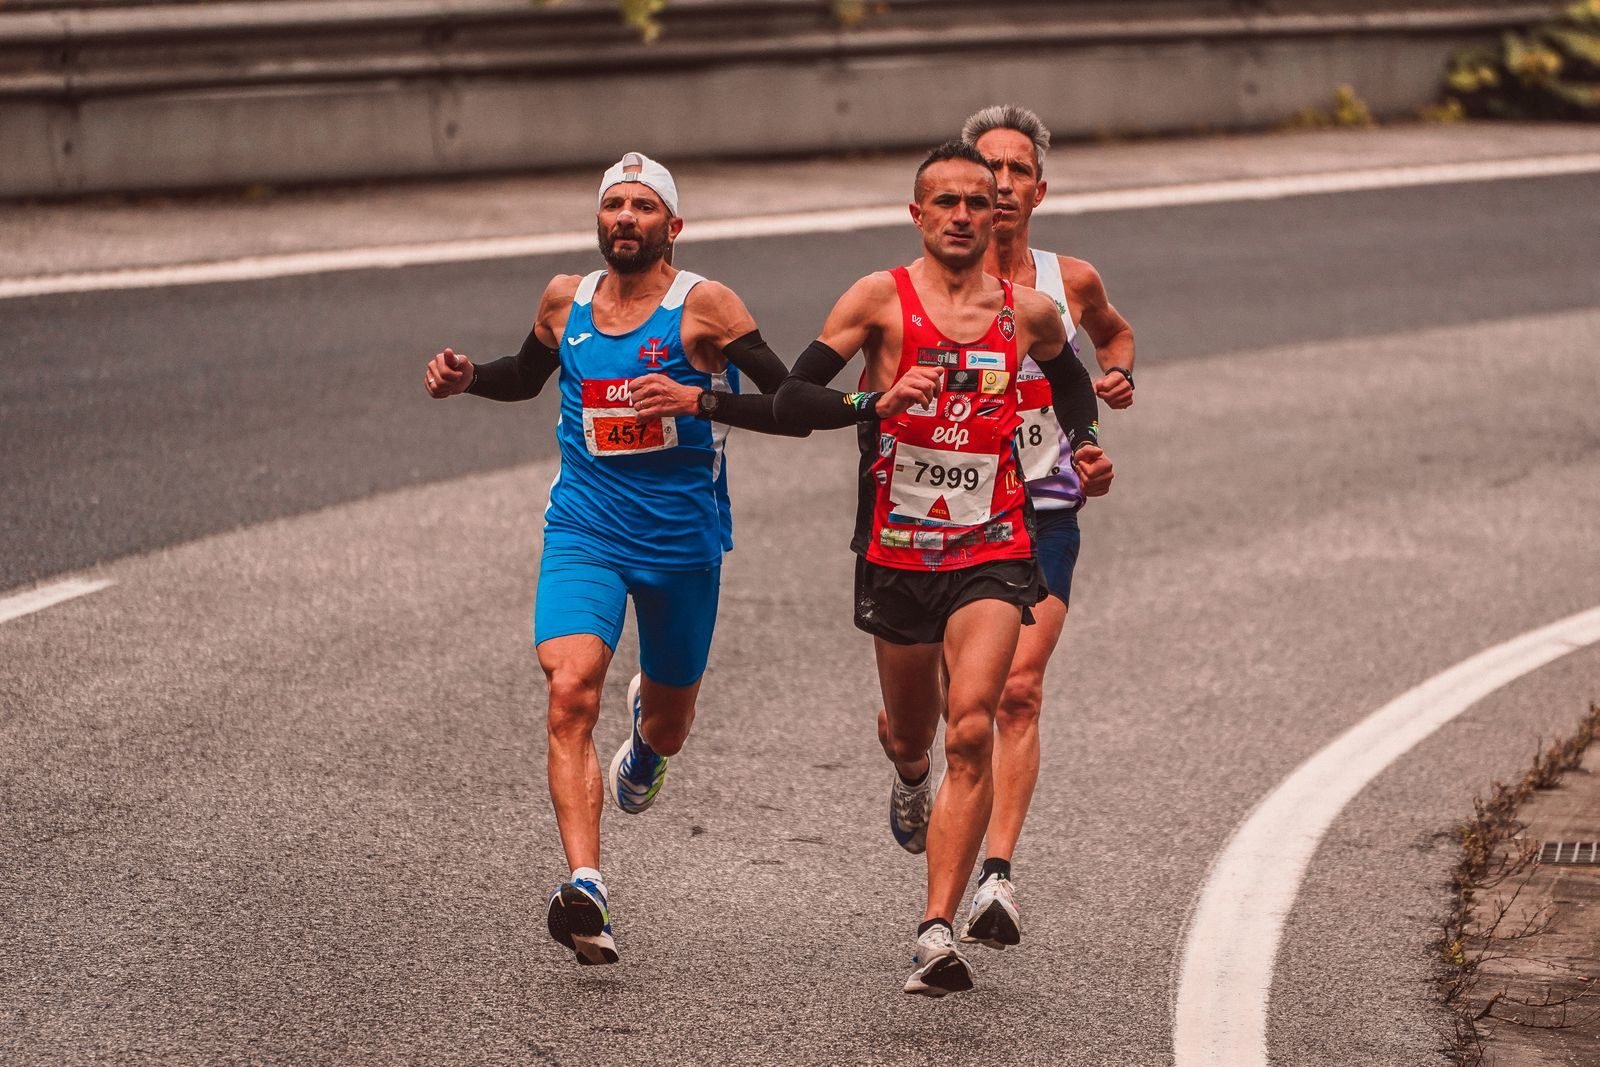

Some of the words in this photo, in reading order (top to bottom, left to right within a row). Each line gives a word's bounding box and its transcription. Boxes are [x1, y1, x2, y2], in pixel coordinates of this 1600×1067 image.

[607, 424, 647, 445] 457
[931, 422, 970, 450] edp
[1016, 424, 1043, 449] 18
[913, 461, 980, 491] 7999
[931, 507, 947, 515] DELTA
